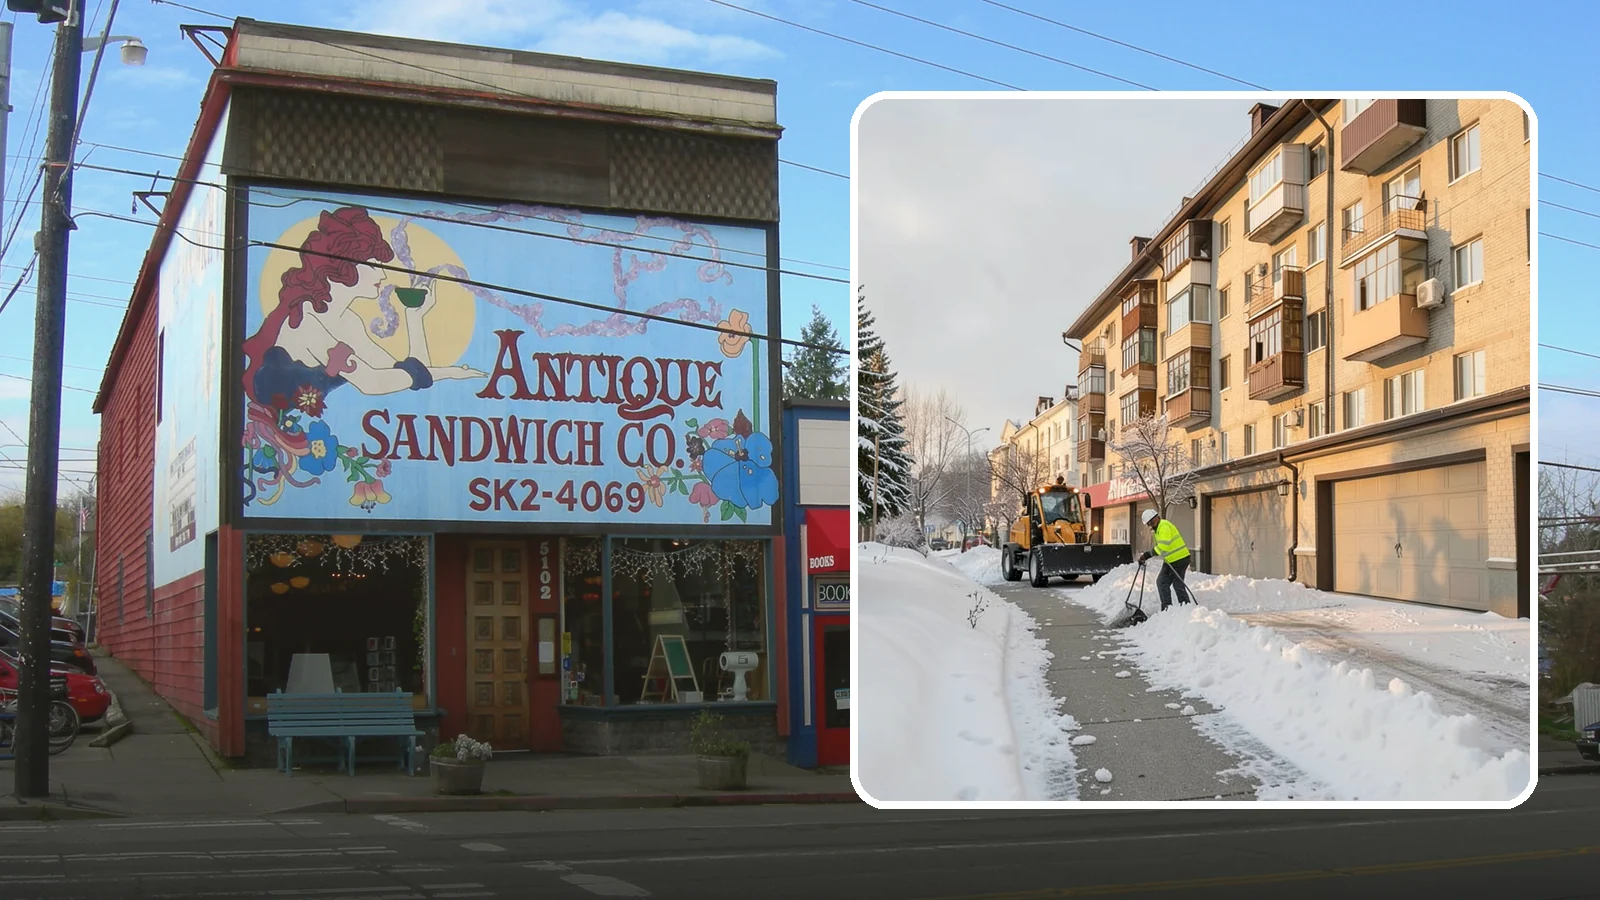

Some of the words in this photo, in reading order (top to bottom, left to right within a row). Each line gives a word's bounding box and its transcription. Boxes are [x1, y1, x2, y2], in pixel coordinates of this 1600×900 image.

[475, 329, 724, 421] ANTIQUE
[361, 408, 605, 467] SANDWICH
[616, 421, 685, 468] CO.
[468, 476, 646, 513] SK2-4069
[539, 541, 551, 600] 5102
[809, 555, 835, 569] BOOKS
